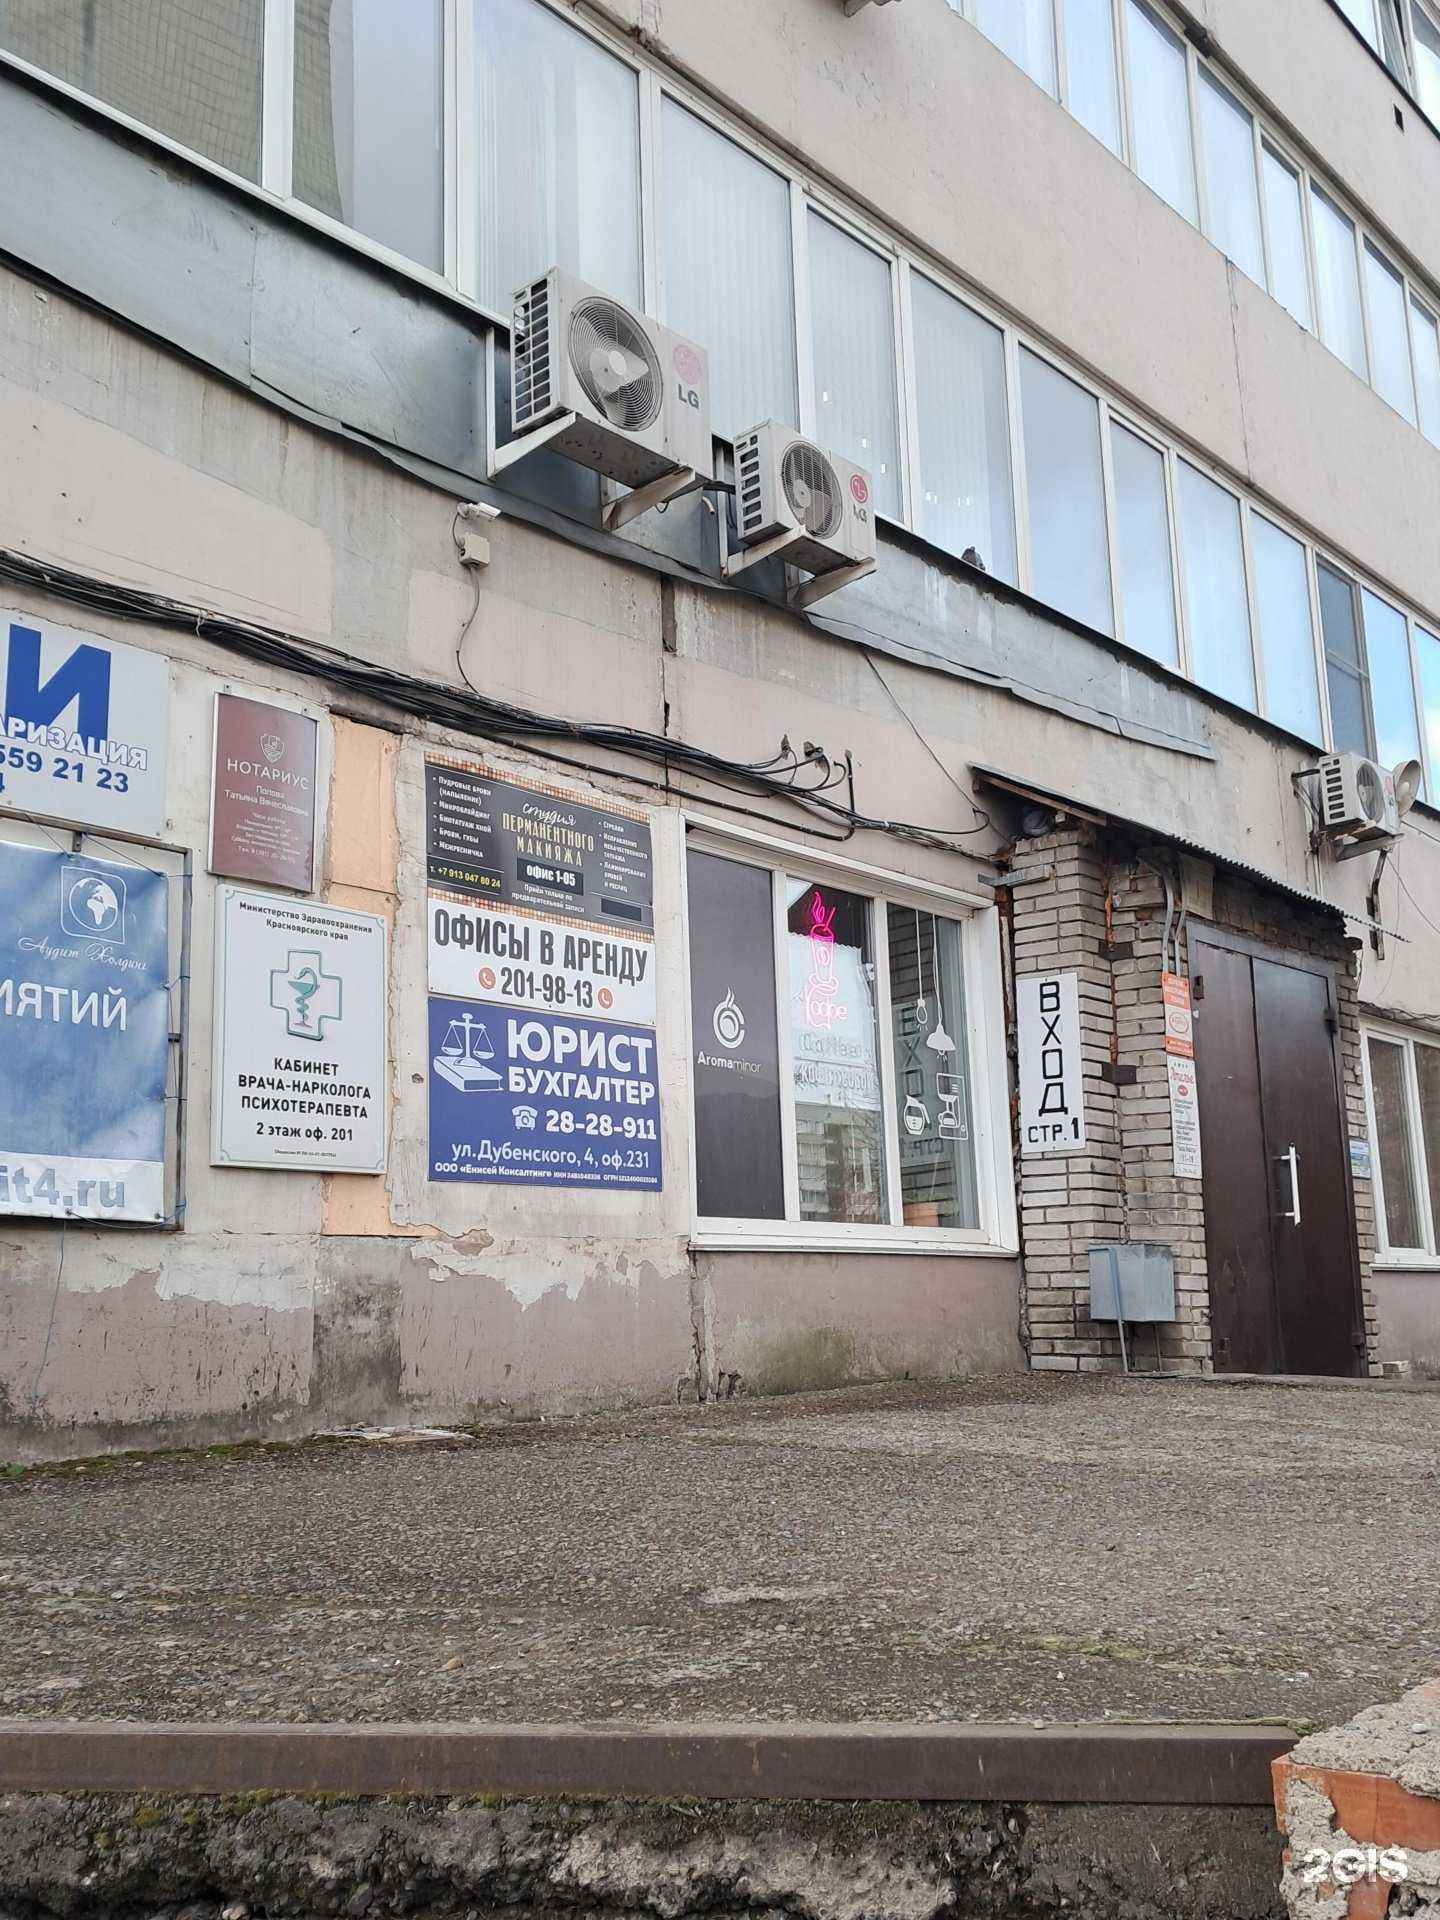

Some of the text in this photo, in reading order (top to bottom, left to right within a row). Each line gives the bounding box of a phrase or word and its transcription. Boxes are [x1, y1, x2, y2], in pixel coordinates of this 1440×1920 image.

[678, 383, 699, 409] LG
[853, 503, 867, 522] LG
[0, 713, 148, 771] РИЗАЦИЯ
[53, 757, 84, 783] 21
[96, 768, 129, 793] 23
[227, 758, 309, 790] НОТАРИУС
[522, 803, 576, 826] студия
[502, 813, 594, 852] ПЕРМАНЕНТНОГО
[517, 836, 582, 867] МАКИЯЖА
[438, 867, 448, 876] +7
[448, 868, 464, 879] 913
[464, 872, 478, 883] 047
[555, 868, 576, 886] 1-05
[240, 902, 372, 934] Министерство Здравоохранения
[266, 918, 349, 941] Красноярского края
[434, 908, 648, 986] ОФИСЫ В АРЕНДУ
[500, 966, 593, 1008] 201-98-13
[506, 1018, 653, 1074] ЮРИСТ
[1038, 981, 1068, 1117] ВХОД
[274, 1058, 339, 1076] КАБИНЕТ
[697, 1050, 762, 1073] Aromaminor
[238, 1074, 371, 1100] ВРАЧА-НАРКОЛОГА
[508, 1066, 655, 1105] БУХГАЛТЕР
[241, 1096, 368, 1118] ПСИХОТЕРАПЕВТА
[256, 1122, 353, 1142] 2 этаж оф. 201
[545, 1109, 657, 1140] 28-28-911
[434, 1162, 458, 1172] ООО
[460, 1164, 497, 1176] «Енисей
[601, 1149, 650, 1171] оф.231
